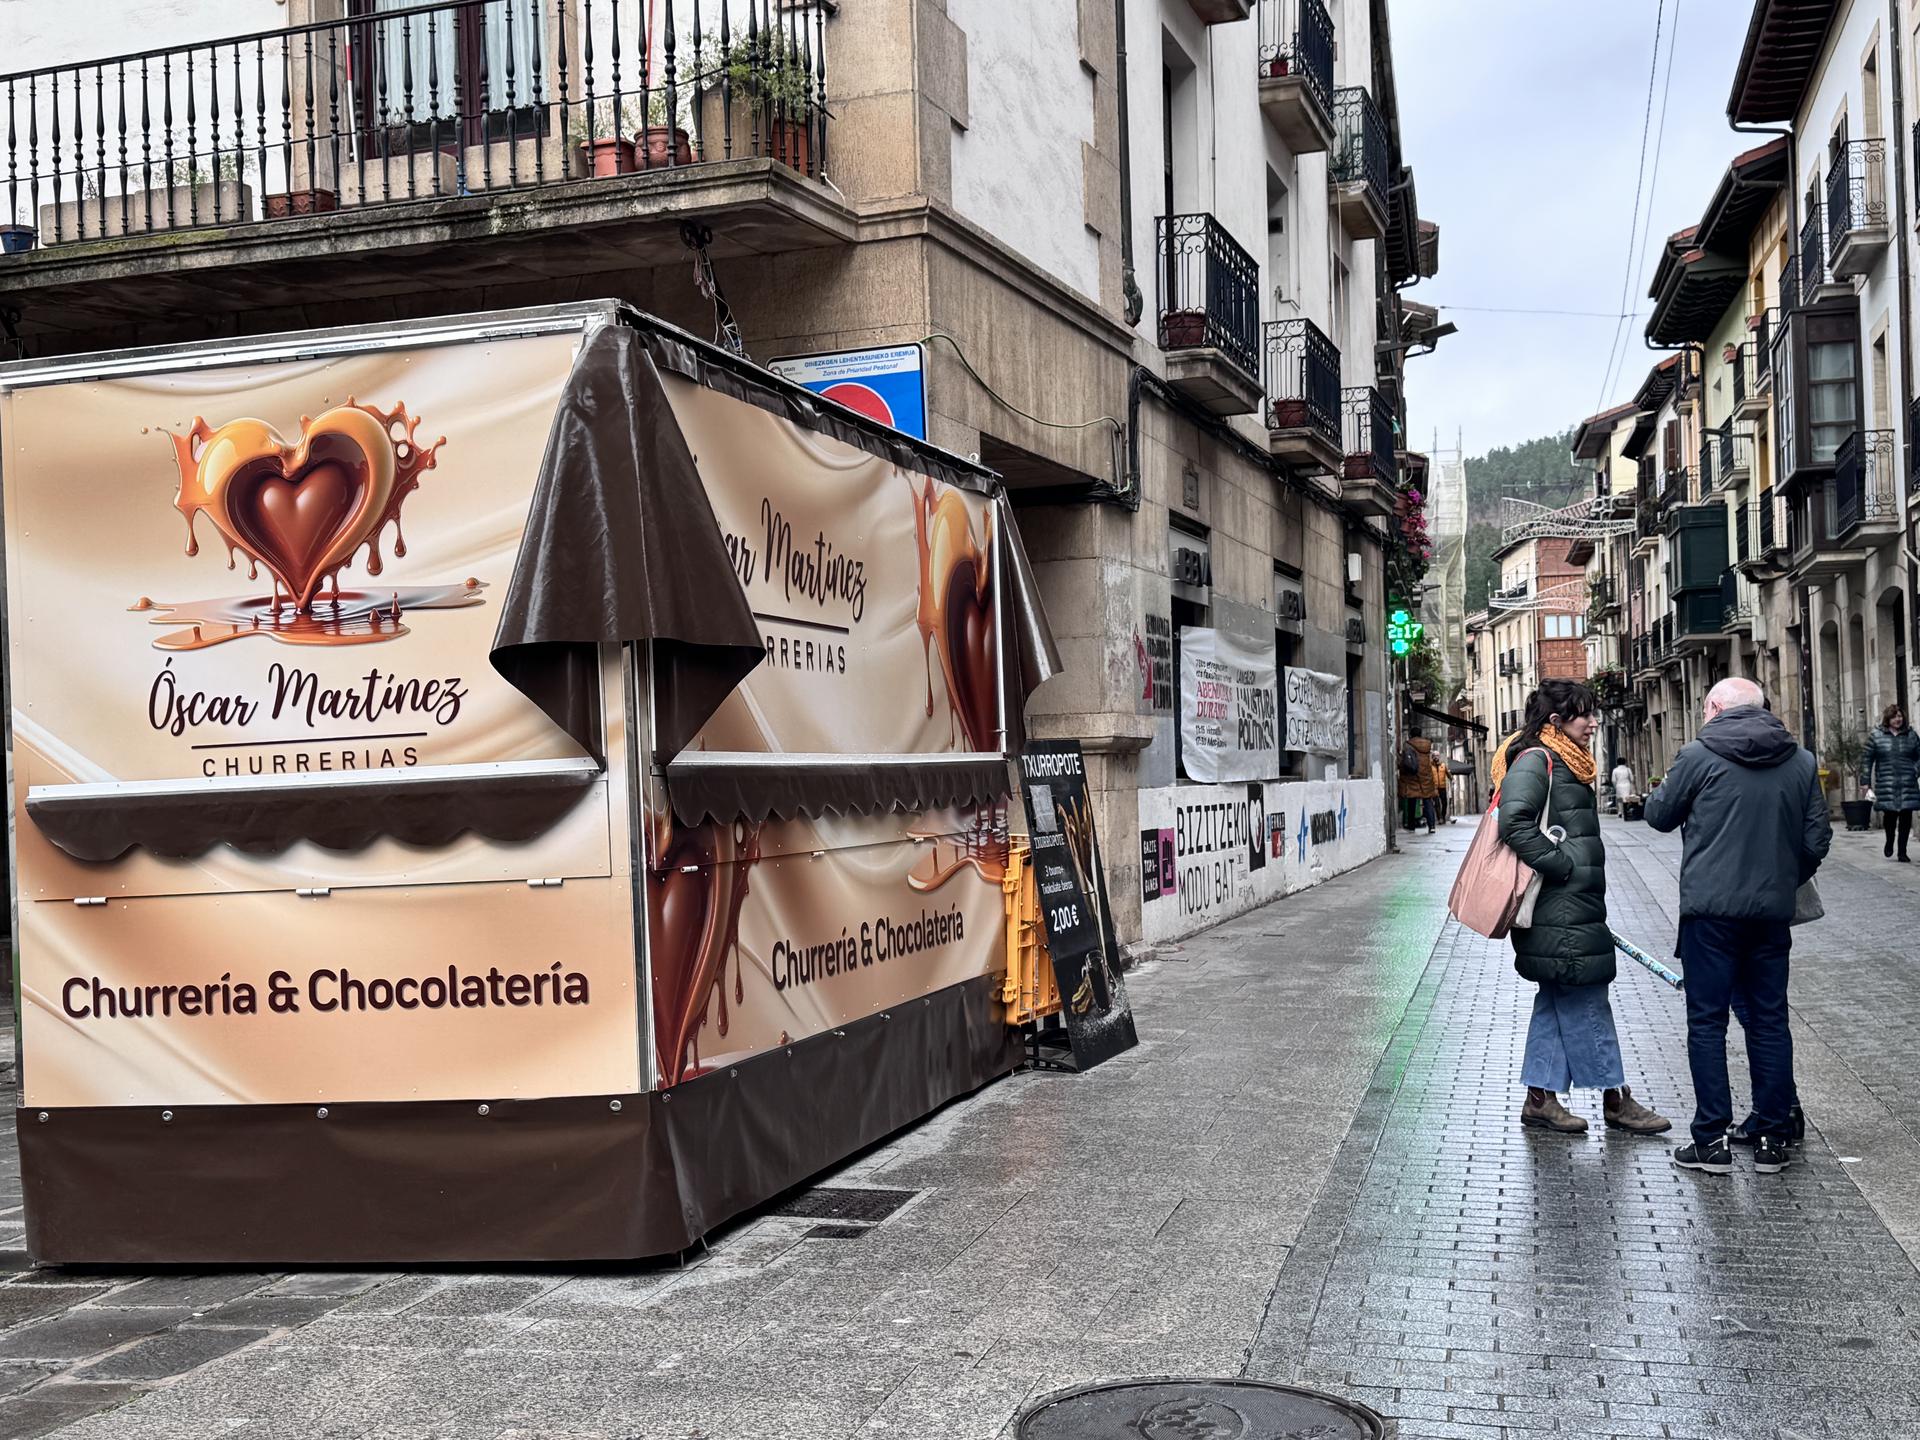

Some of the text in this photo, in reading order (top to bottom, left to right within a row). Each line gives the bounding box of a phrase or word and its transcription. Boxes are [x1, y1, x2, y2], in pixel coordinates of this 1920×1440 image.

[805, 350, 915, 368] OINEZKOEN LEHENTASUNEKO EREMUA
[823, 368, 837, 376] Zona
[837, 367, 846, 375] de
[873, 363, 898, 371] Peatonal
[759, 497, 868, 622] Martínez
[766, 635, 847, 674] RRERIAS
[148, 657, 469, 737] Óscar Martínez
[202, 746, 419, 778] CHURRERIAS
[1021, 753, 1082, 778] TXURROPOTE
[1177, 801, 1248, 857] BIZITZEKO
[1178, 858, 1235, 917] MODU BAT
[1051, 904, 1080, 934] 2,00 €
[772, 903, 964, 991] Churrería & Chocolatería
[62, 961, 590, 1019] Churrería & Chocolatería
